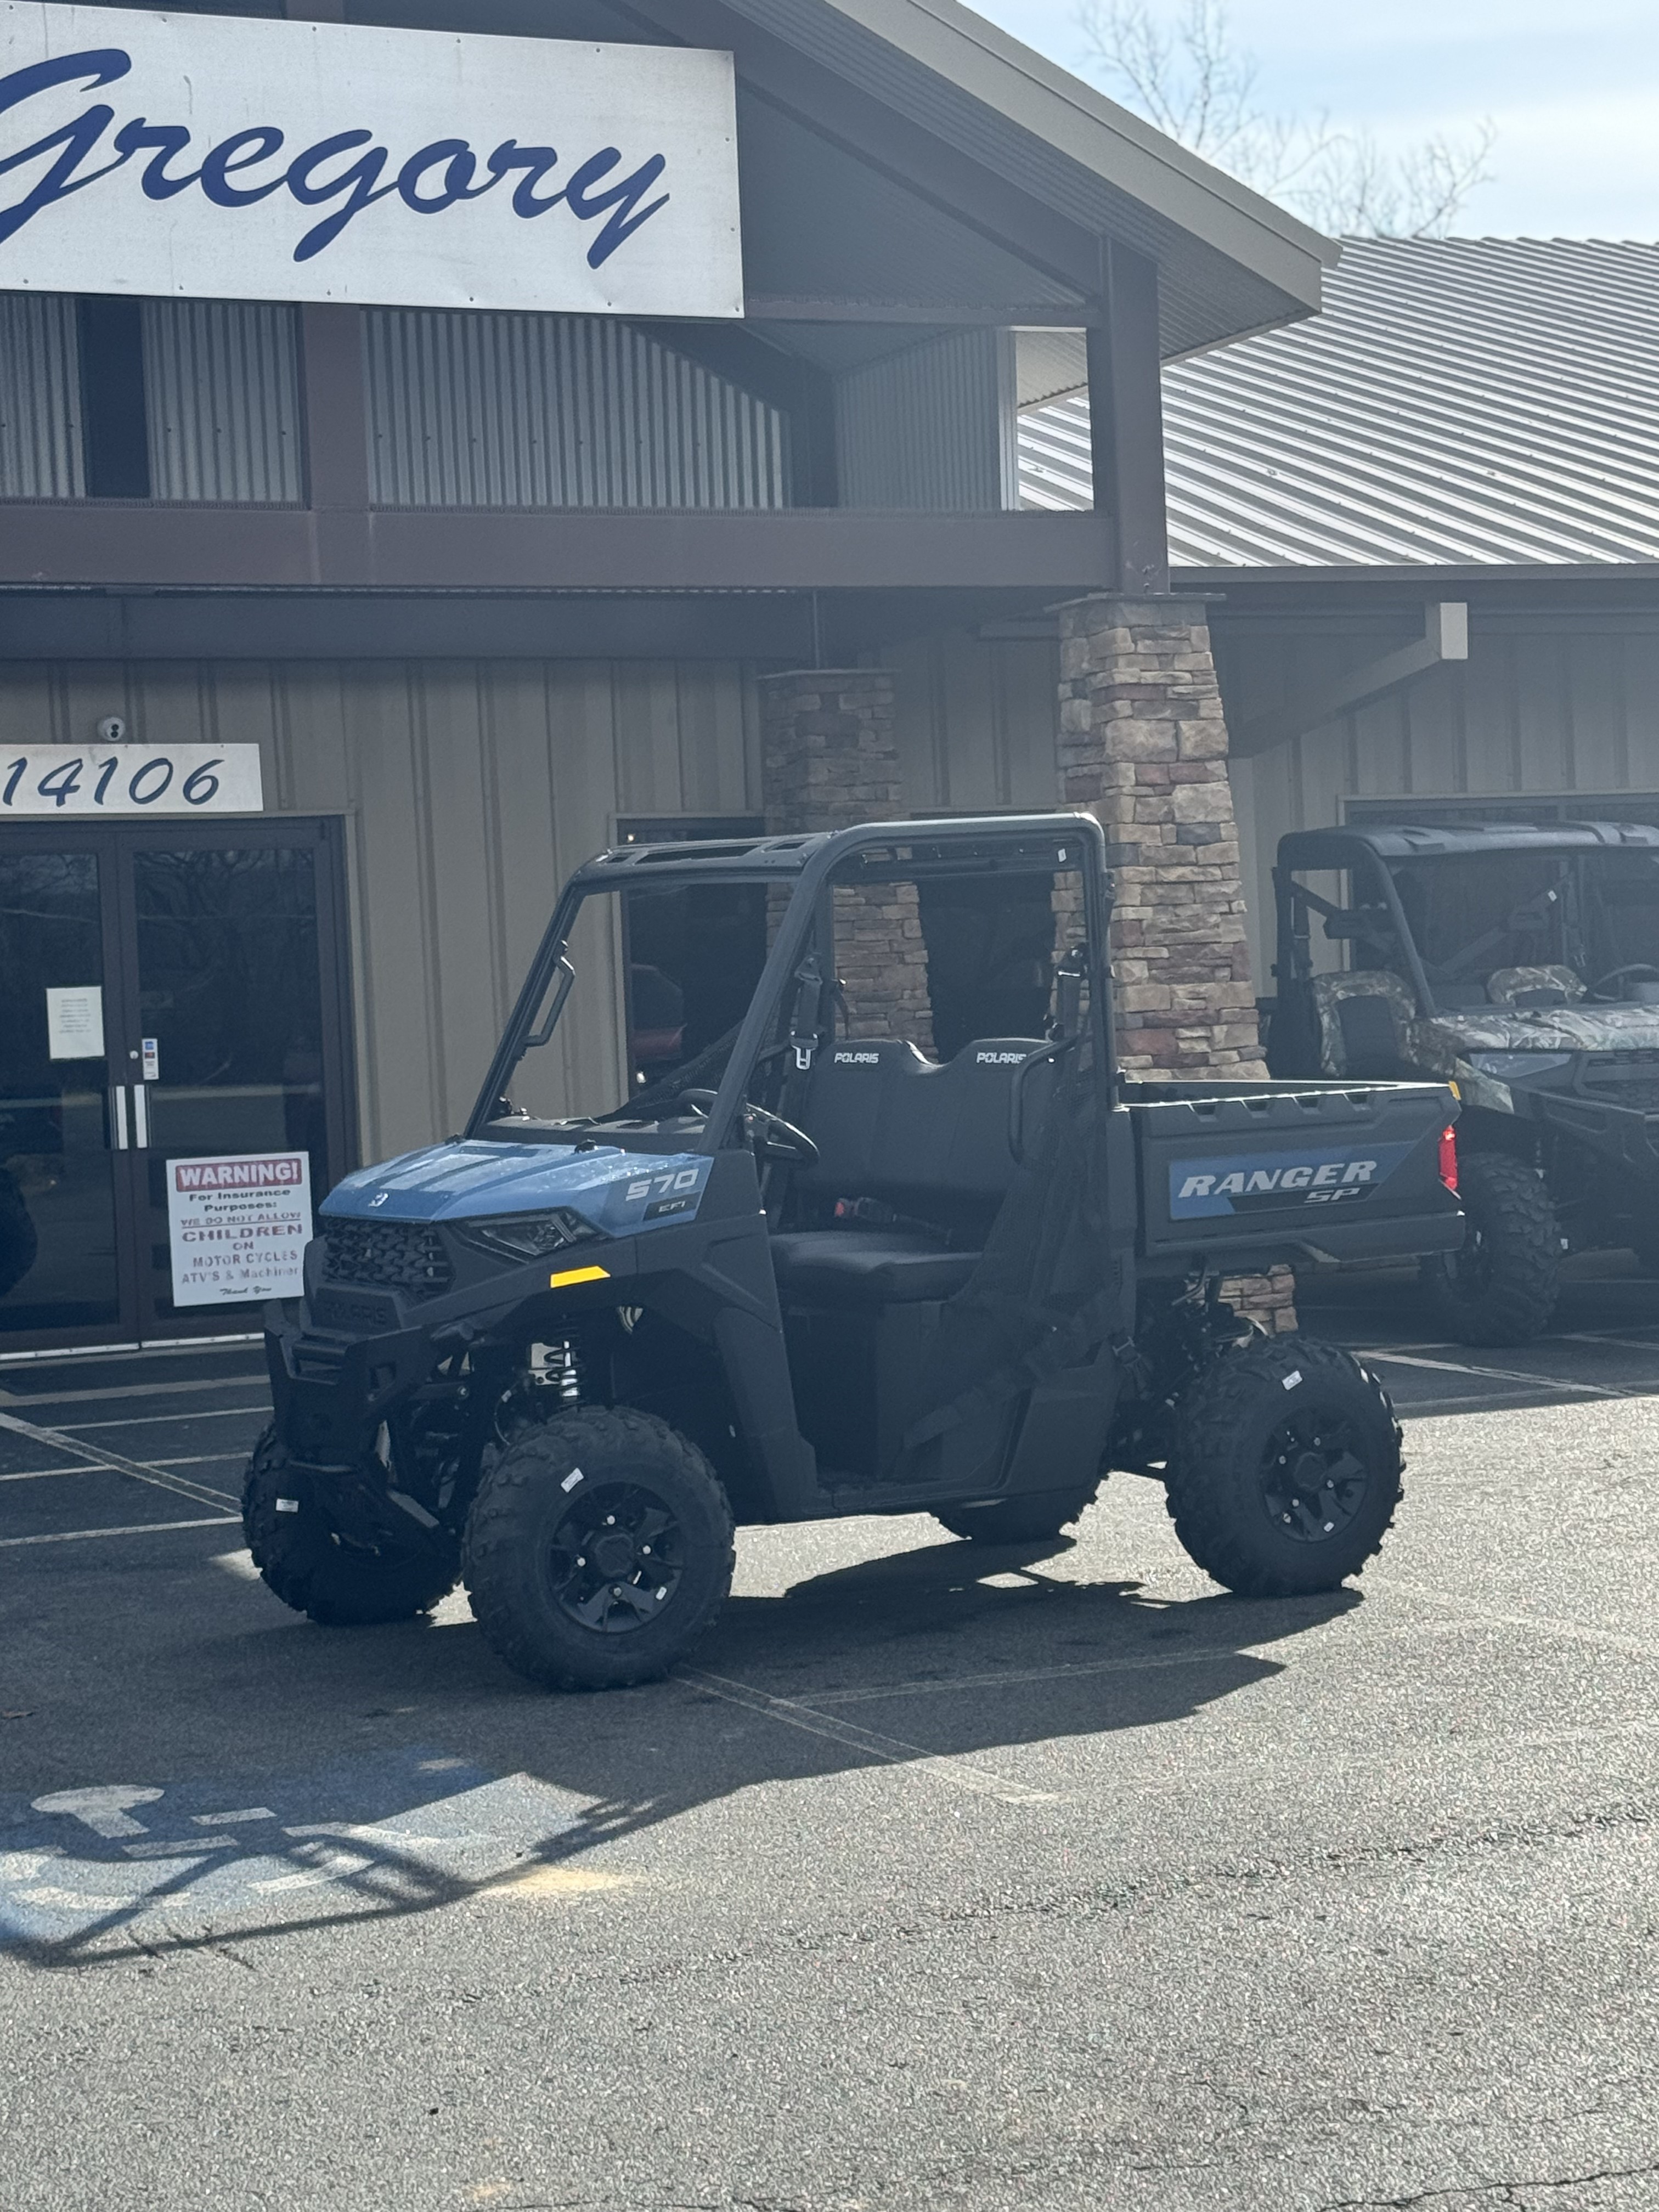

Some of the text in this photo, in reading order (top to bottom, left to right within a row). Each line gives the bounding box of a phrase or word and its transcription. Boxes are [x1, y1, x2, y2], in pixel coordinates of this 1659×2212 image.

[2, 756, 225, 808] 14106
[834, 1052, 879, 1064] POLARIS
[179, 1161, 298, 1187] WARNING!
[1178, 1160, 1378, 1198] RANGER
[625, 1169, 699, 1201] 570
[189, 1189, 291, 1202] For Insurance
[1304, 1187, 1361, 1204] SP
[204, 1201, 278, 1212] Purposes:
[658, 1200, 686, 1213] EFI
[180, 1211, 301, 1226] WE DO NOT ALLOW
[182, 1223, 302, 1243] CHILDREN
[233, 1241, 255, 1251] ON
[193, 1250, 298, 1268] MOTOR CYCLES
[225, 1270, 234, 1280] &
[219, 1285, 272, 1295] Thank You
